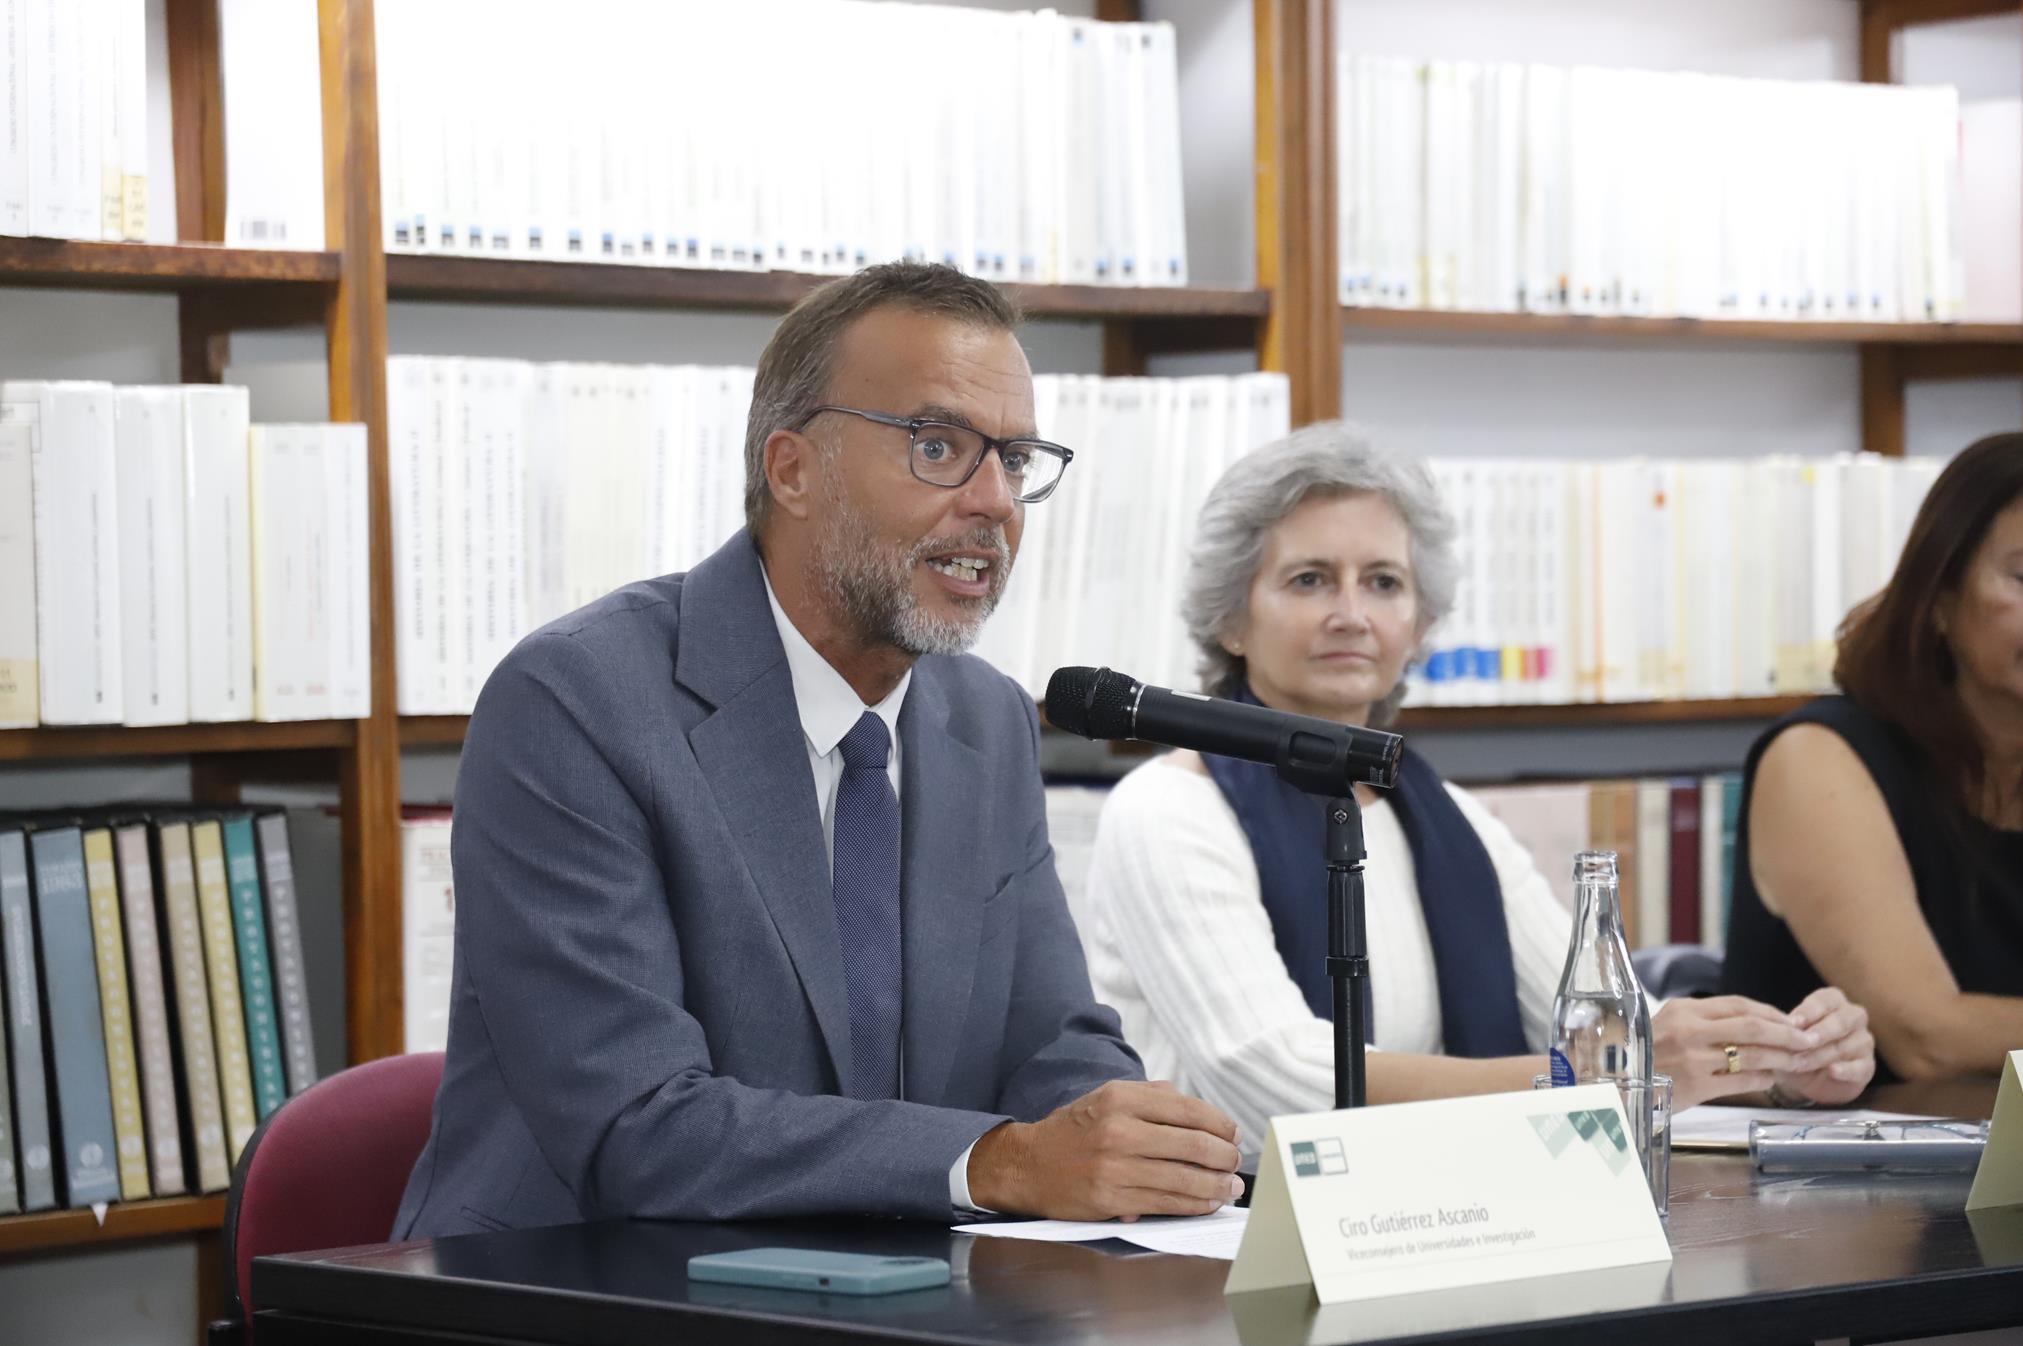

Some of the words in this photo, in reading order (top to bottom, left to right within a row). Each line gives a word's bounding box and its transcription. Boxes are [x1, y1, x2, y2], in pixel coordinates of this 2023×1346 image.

[1338, 1216, 1368, 1239] Ciro
[1370, 1209, 1435, 1235] Gutiérrez
[1437, 1202, 1489, 1227] Ascanio
[1405, 1241, 1416, 1254] de
[1417, 1234, 1474, 1254] Universidades
[1475, 1236, 1482, 1246] e
[1482, 1227, 1536, 1246] Investigación
